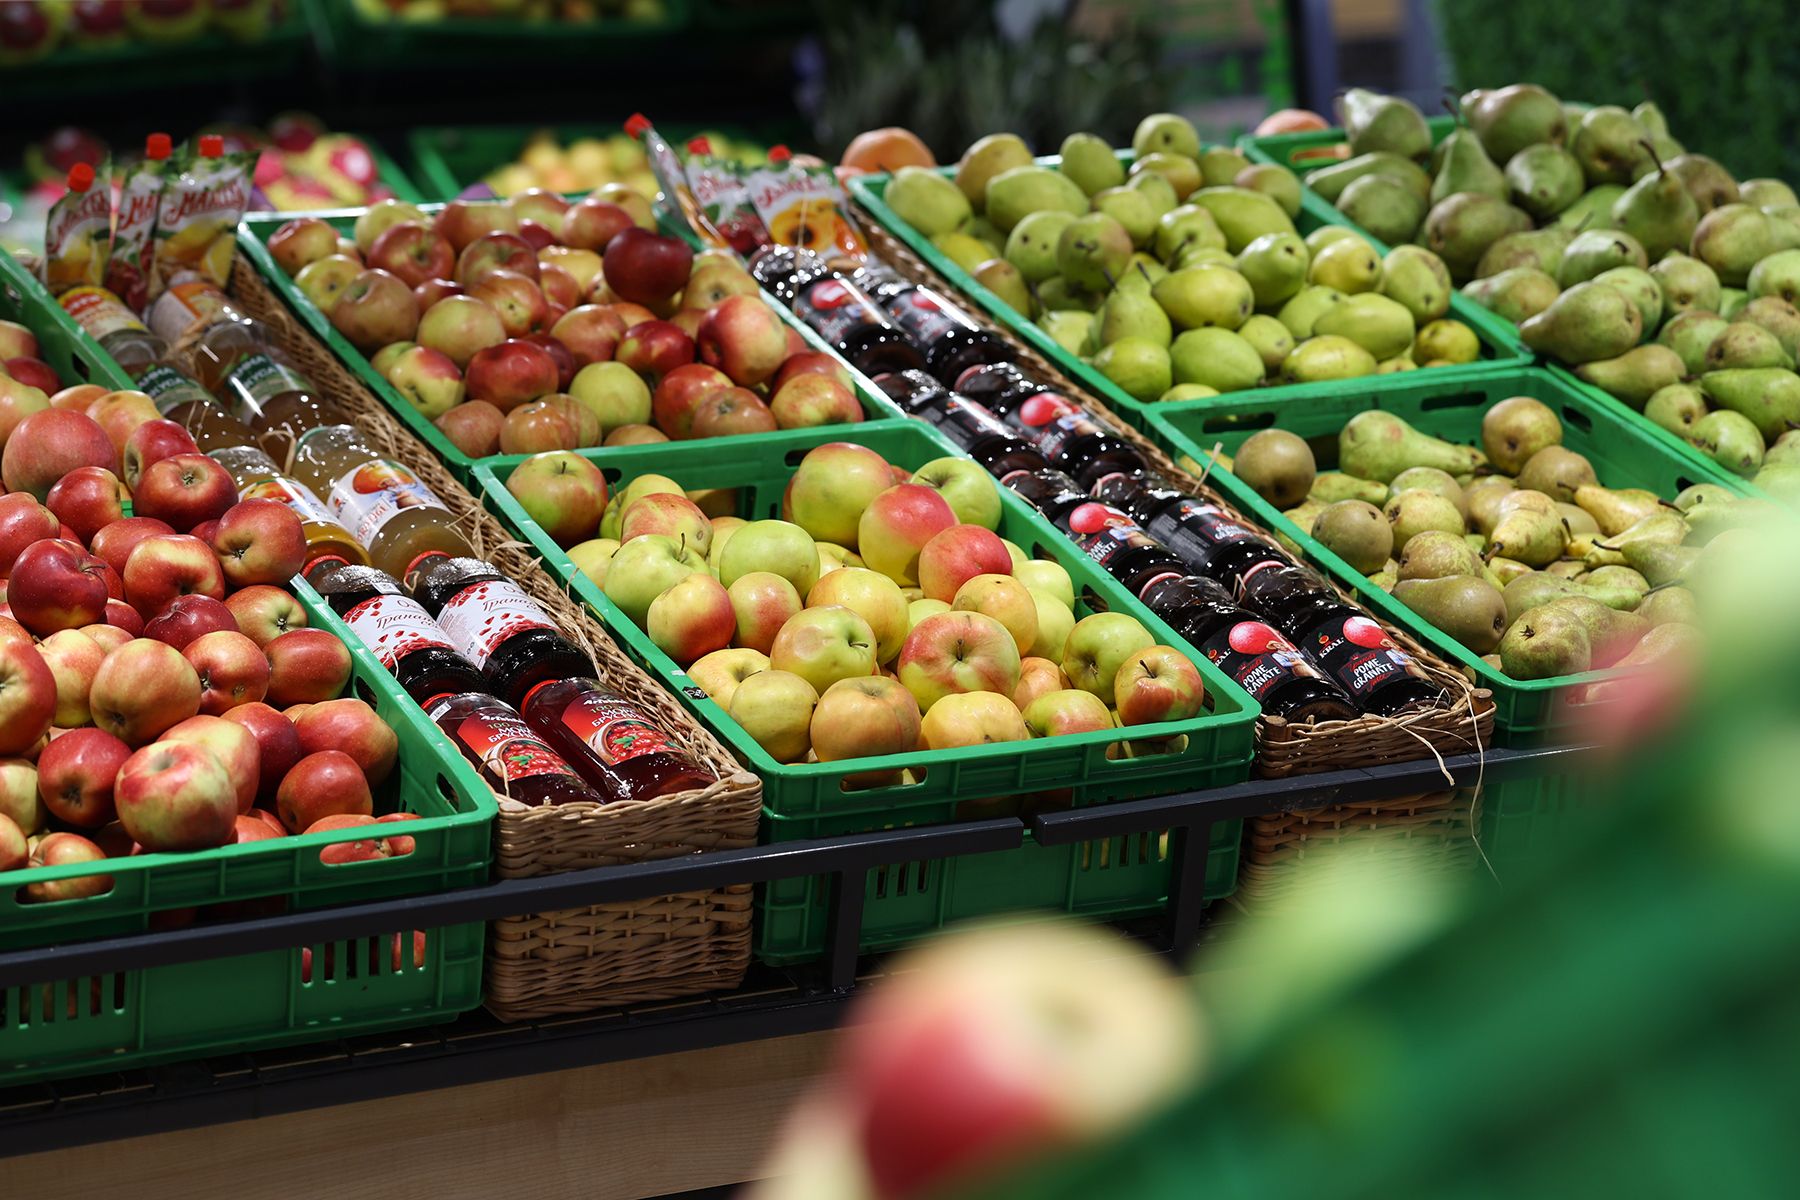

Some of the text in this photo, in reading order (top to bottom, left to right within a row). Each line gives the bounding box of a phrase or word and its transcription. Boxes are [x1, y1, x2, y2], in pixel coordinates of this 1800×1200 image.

[1215, 650, 1232, 667] RAL
[1319, 638, 1344, 658] KRAL
[1242, 664, 1268, 688] POME
[1353, 658, 1382, 677] POME
[1353, 662, 1394, 689] GRANATE
[1247, 666, 1281, 695] RANATE
